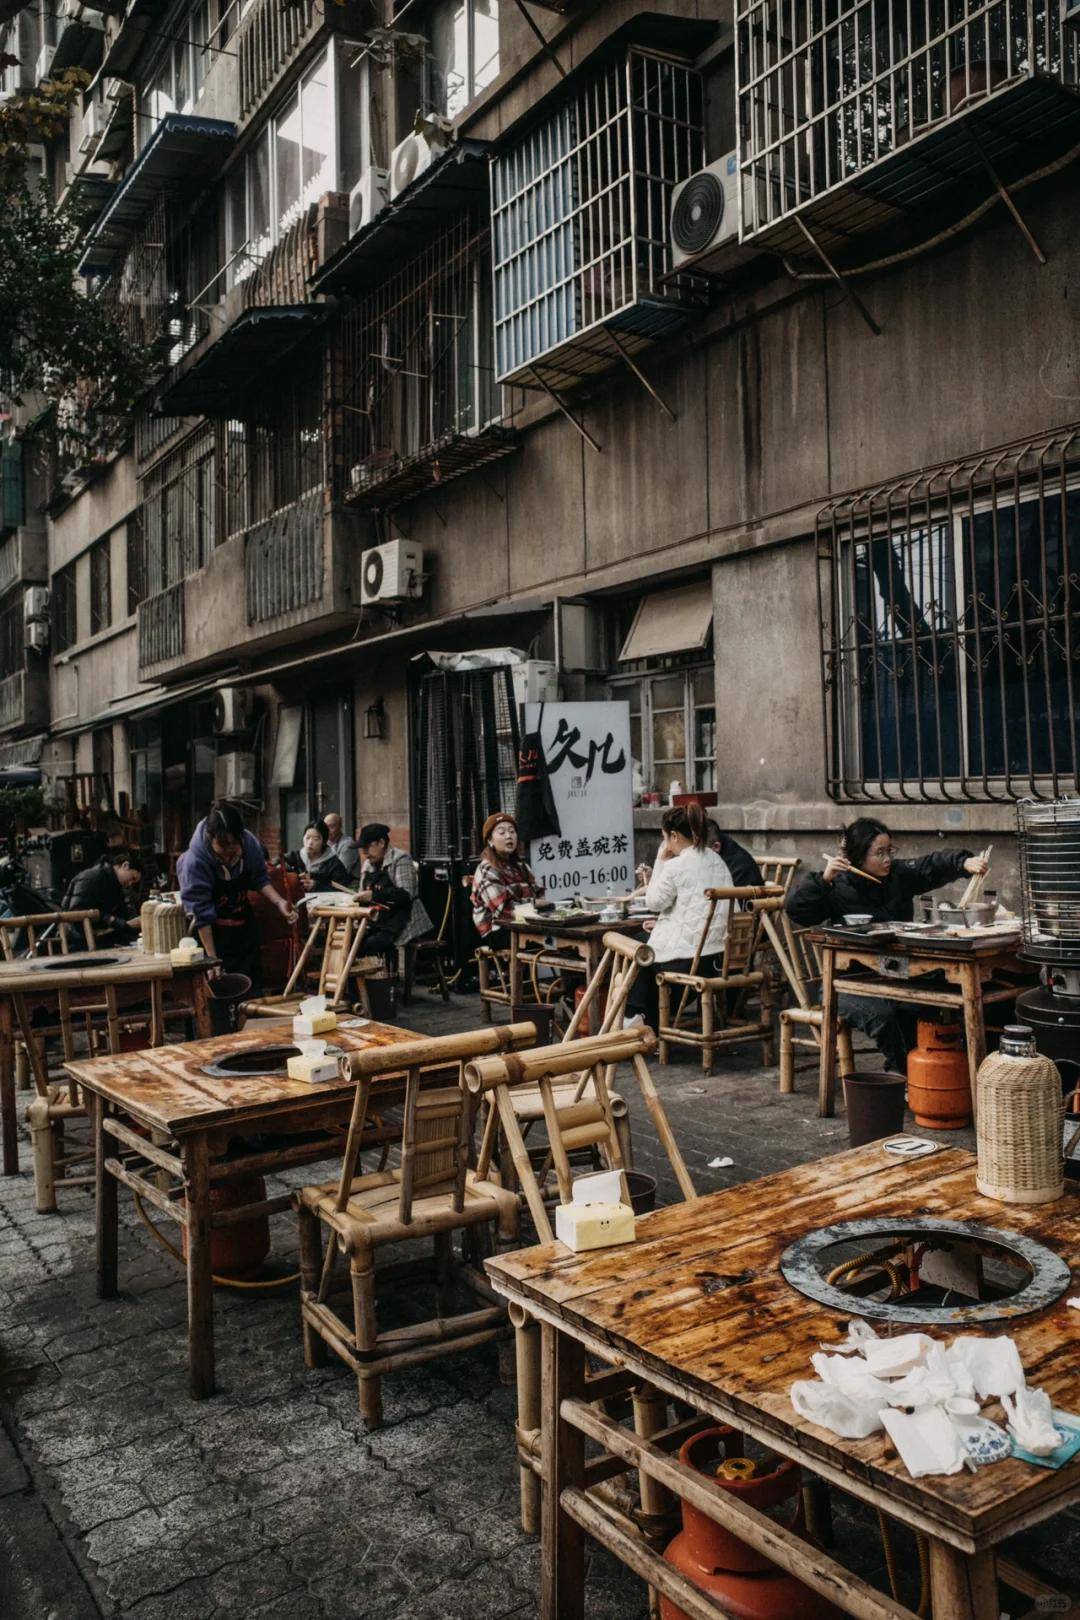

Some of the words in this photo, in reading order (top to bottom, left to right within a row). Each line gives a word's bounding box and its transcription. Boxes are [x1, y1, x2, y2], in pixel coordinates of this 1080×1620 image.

[538, 834, 628, 862] 免费盖碗茶
[541, 865, 628, 889] 10:00-16:00
